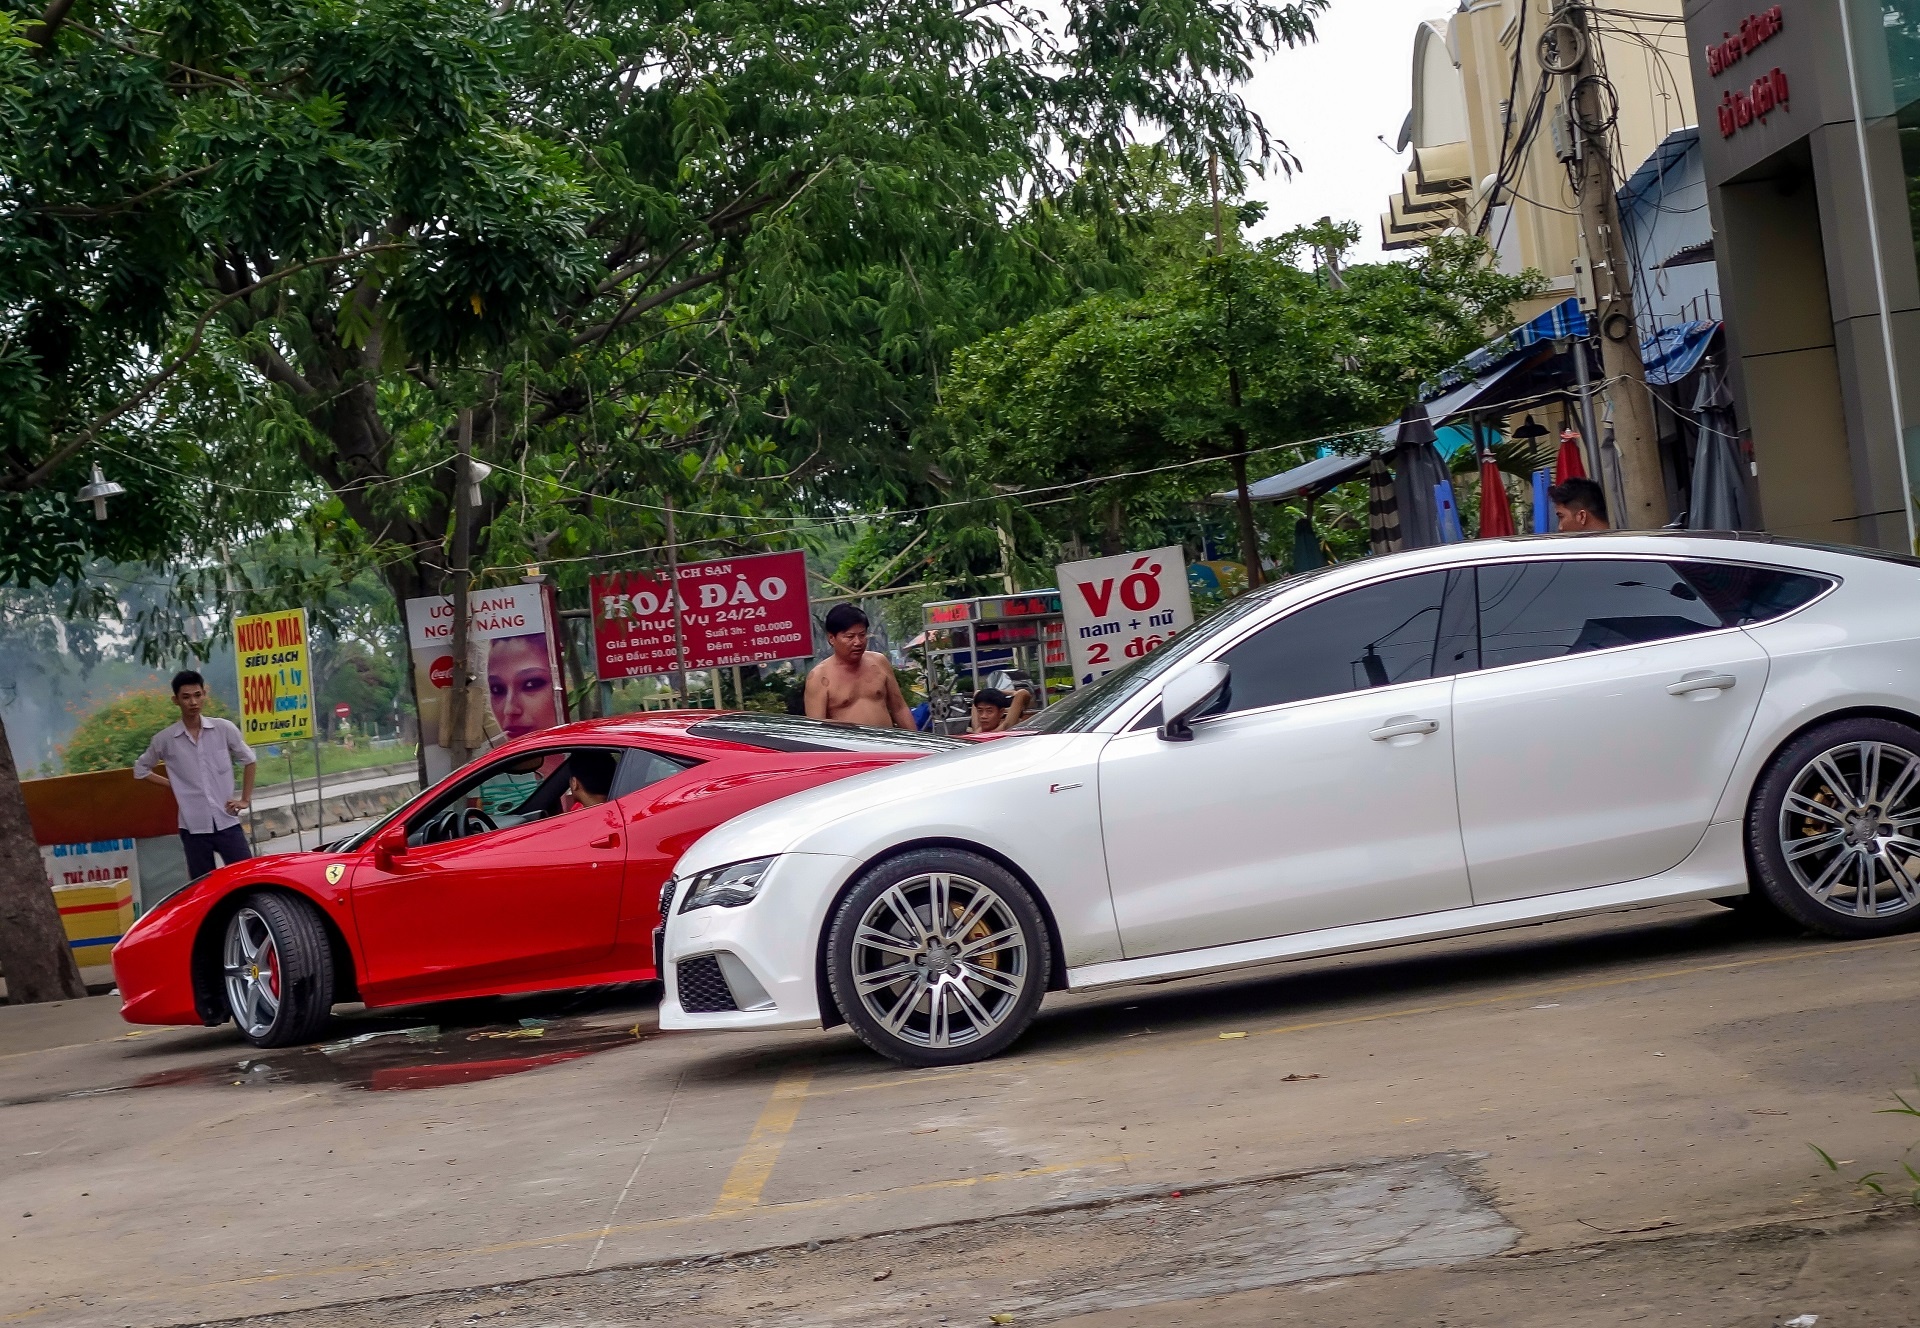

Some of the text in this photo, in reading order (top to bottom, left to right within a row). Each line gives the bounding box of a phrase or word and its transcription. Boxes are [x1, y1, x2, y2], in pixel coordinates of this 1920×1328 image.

[704, 565, 732, 577] SẠN
[602, 574, 787, 620] HOA ĐÀO
[1077, 556, 1162, 618] VỚ
[470, 597, 515, 615] LẠNH
[477, 612, 525, 632] NẮNG
[683, 614, 710, 627] Vụ
[715, 606, 767, 623] 24/24
[1079, 608, 1175, 639] nam + nữ
[237, 613, 303, 653] NƯỚC MÍA
[606, 640, 627, 649] Giá
[631, 637, 660, 647] Bình
[651, 646, 690, 659] 50.00Đ
[707, 642, 733, 651] Đêm
[1086, 631, 1176, 665] 2 đô
[245, 650, 299, 669] SIÊU SẠCH
[626, 665, 652, 675] Wifi
[696, 659, 714, 668] Xe
[717, 652, 750, 665] Miễn
[754, 651, 777, 661] Phí
[279, 669, 286, 686] 1
[246, 718, 258, 733] 10
